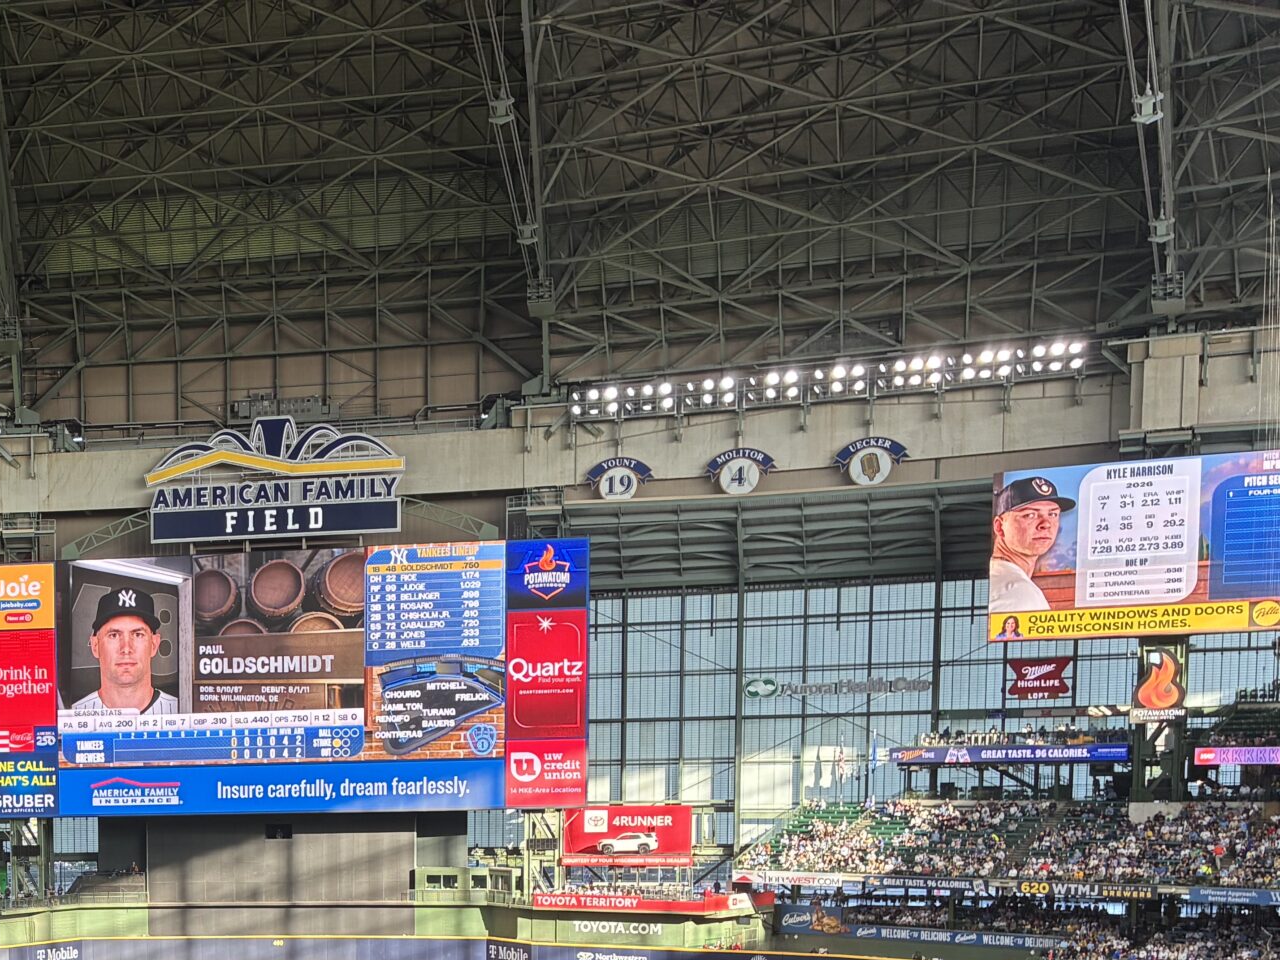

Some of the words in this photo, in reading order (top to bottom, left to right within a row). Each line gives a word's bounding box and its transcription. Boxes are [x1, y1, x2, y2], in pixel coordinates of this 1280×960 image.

[849, 438, 892, 453] UECKER
[601, 458, 637, 469] YOUNT
[716, 450, 764, 465] MOLITOR
[1106, 466, 1127, 480] KYLE
[1129, 464, 1173, 478] HARRISON
[605, 475, 634, 496] 19
[153, 482, 291, 509] AMERICAN
[302, 476, 398, 500] FAMILY
[225, 506, 323, 533] FIELD
[524, 571, 570, 584] POTAWATOMI
[400, 592, 440, 600] BELLINGER
[400, 602, 433, 610] ROSARIO
[1028, 611, 1086, 626] QUALITY
[1088, 609, 1158, 623] WINDOWS
[1161, 606, 1192, 618] AND
[1195, 604, 1244, 616] DOORS
[1028, 623, 1057, 635] FOR
[1059, 620, 1133, 633] WISCONSIN
[1138, 618, 1191, 631] HOMES.
[199, 645, 224, 655] PAUL
[199, 655, 334, 675] GOLDSCHMIDT
[508, 658, 583, 682] Quartz
[34, 665, 47, 680] in
[1022, 663, 1057, 680] Miller
[426, 682, 467, 691] MITCHELL
[1041, 679, 1060, 687] LIFE
[385, 690, 421, 699] CHOURIO
[455, 693, 490, 701] FRELICK
[381, 703, 423, 711] HAMILTON
[422, 708, 456, 716] TURANG
[1133, 709, 1185, 717] POTAWATOMI
[375, 730, 422, 738] CONTRERAS
[36, 736, 56, 746] 250
[981, 749, 1006, 759] GREAT
[1008, 748, 1034, 758] TASTE.
[1036, 748, 1046, 758] 96
[1048, 747, 1090, 758] CALORIES.
[544, 759, 581, 770] credit
[31, 774, 56, 786] ALL!
[544, 770, 581, 780] union
[93, 787, 141, 797] AMERICAN
[145, 787, 179, 796] FAMILY
[217, 781, 263, 799] Insure
[268, 778, 336, 801] carefully,
[340, 778, 385, 796] dream
[390, 777, 470, 799] fearlessly.
[612, 815, 672, 827] 4RUNNER
[883, 878, 903, 886] GREAT
[905, 879, 926, 887] TASTE.
[927, 879, 937, 888] 96
[938, 879, 972, 888] CALORIES.
[1020, 882, 1050, 894] 620
[1052, 883, 1099, 896] WTMJ
[1103, 890, 1152, 899] BREWERS
[537, 895, 577, 906] TOYOTA
[580, 895, 638, 907] TERRITORY
[573, 920, 662, 935] TOYOTA.COM
